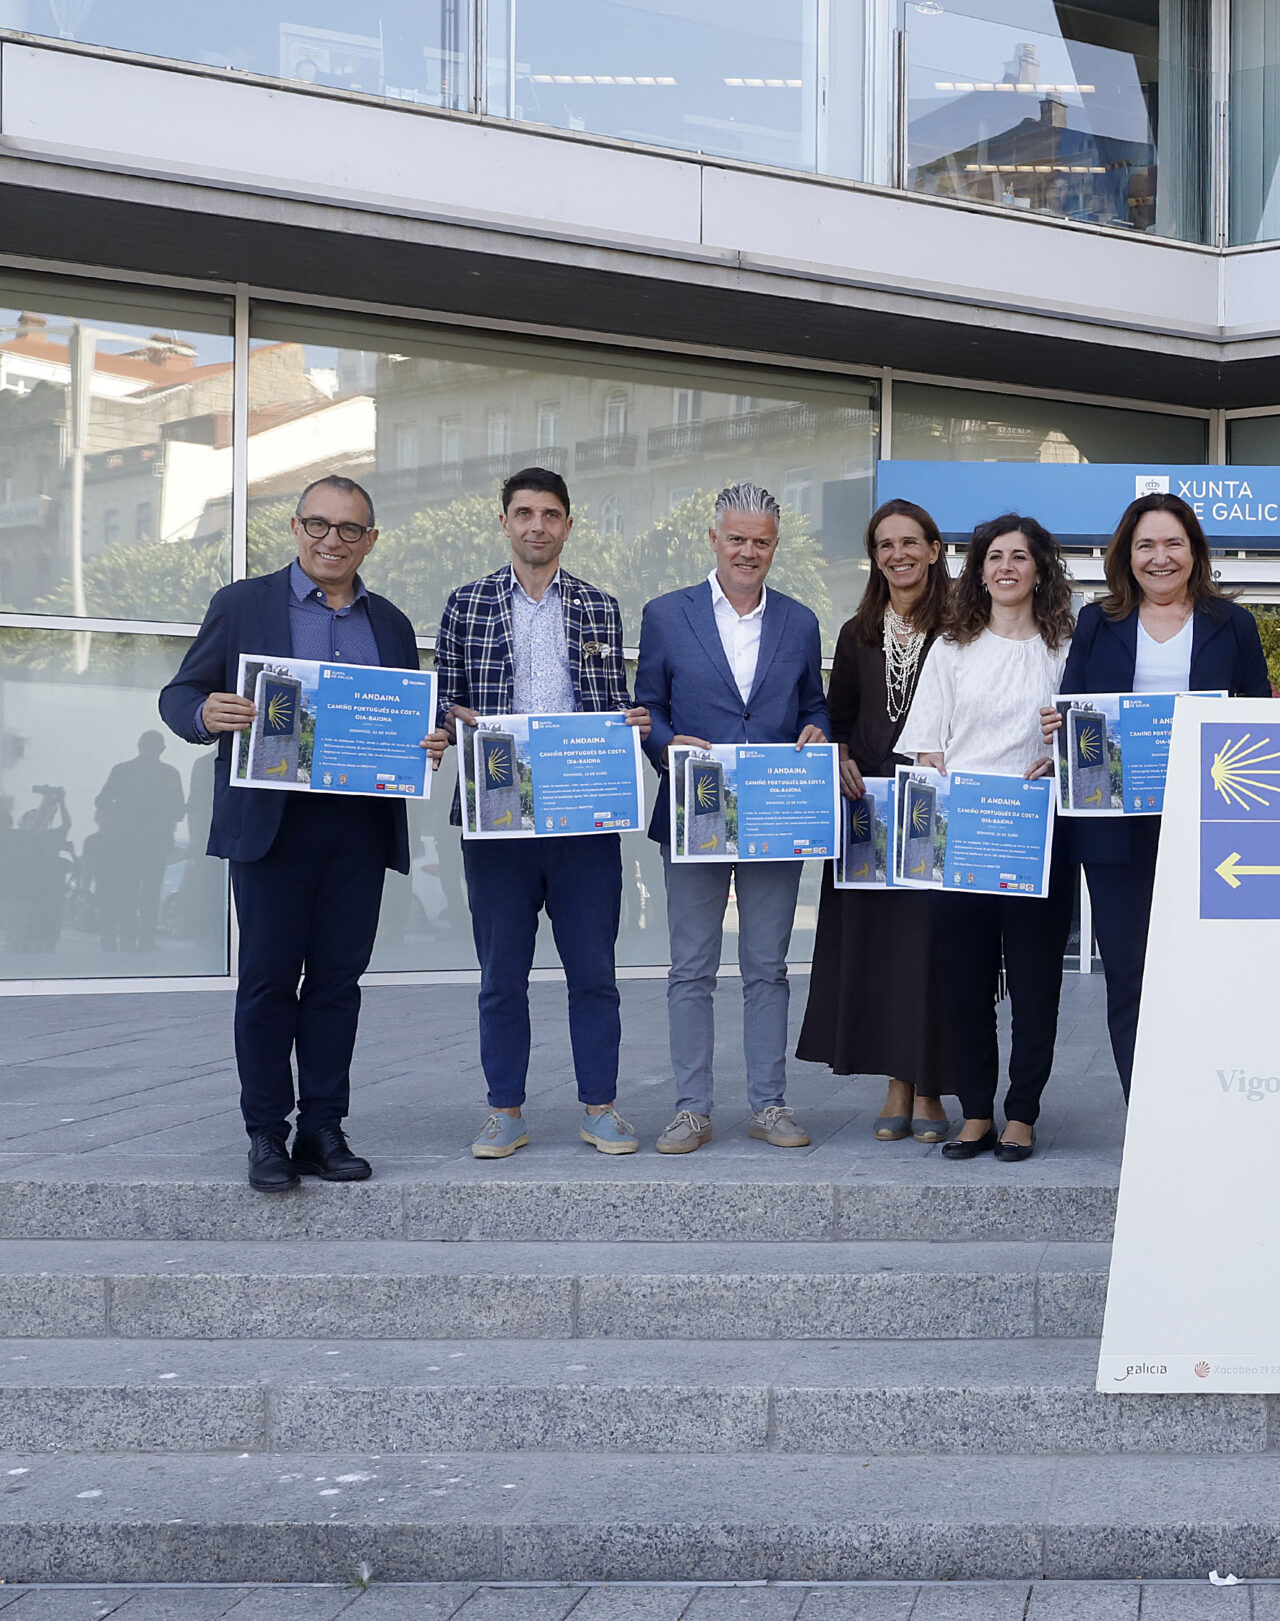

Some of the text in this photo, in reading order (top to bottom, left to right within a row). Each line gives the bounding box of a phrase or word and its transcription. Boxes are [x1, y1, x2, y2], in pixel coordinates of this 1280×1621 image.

[1177, 480, 1253, 499] XUNTA
[362, 694, 400, 702] ANDAINA
[1115, 1363, 1167, 1380] galicia
